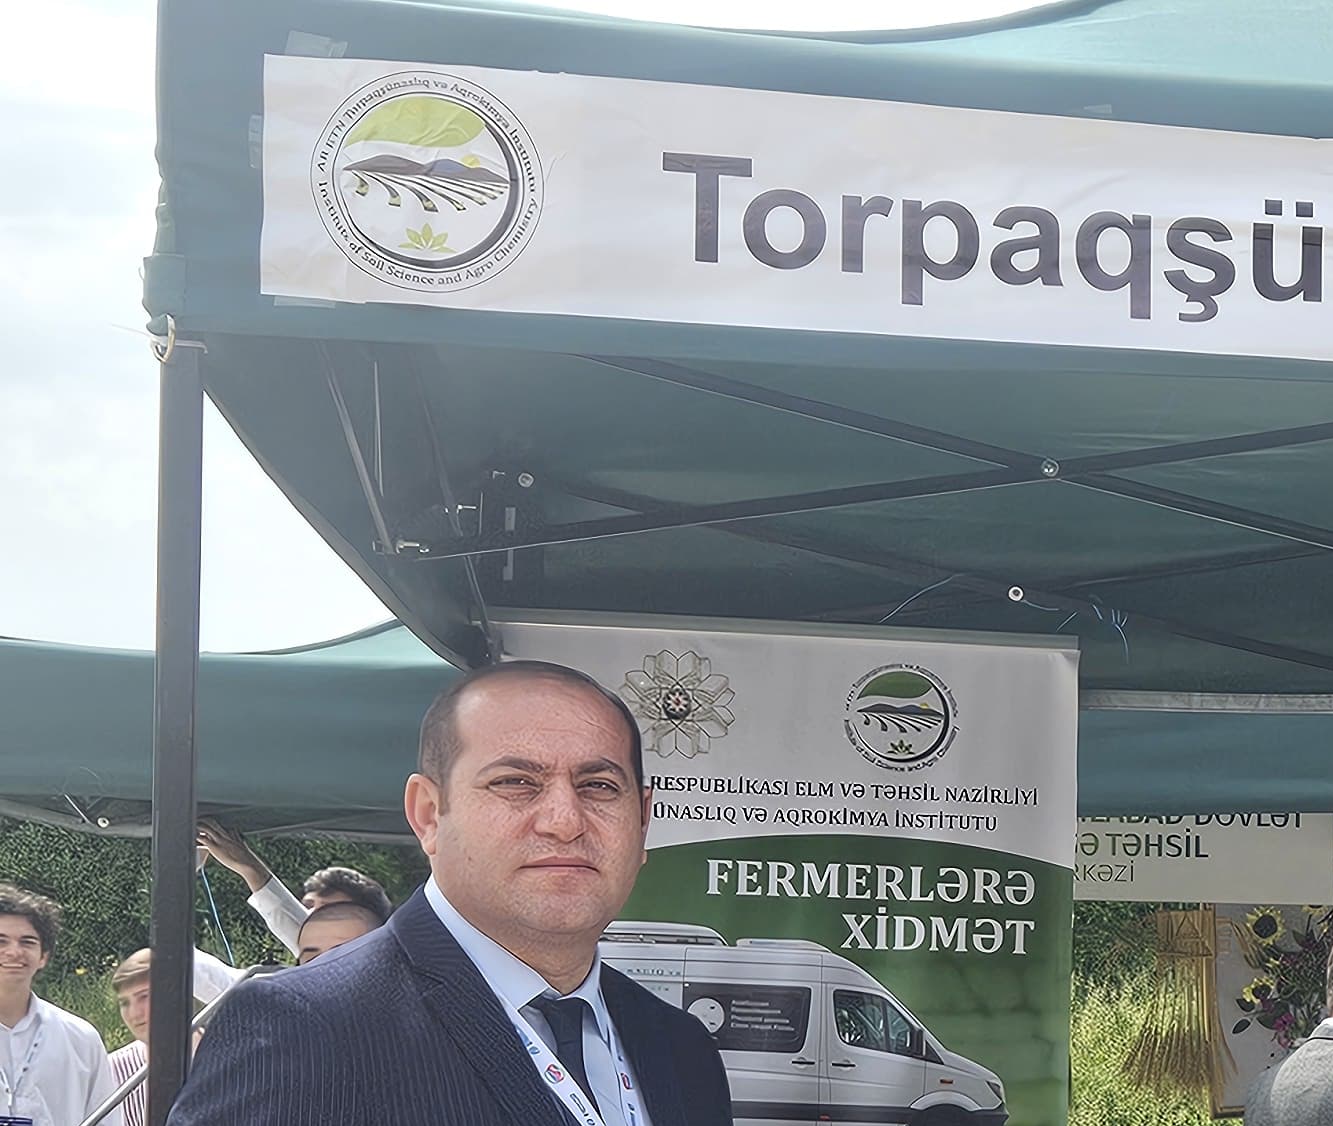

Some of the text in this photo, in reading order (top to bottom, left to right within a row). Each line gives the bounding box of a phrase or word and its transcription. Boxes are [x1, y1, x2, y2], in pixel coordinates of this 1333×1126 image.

[795, 780, 834, 798] ELM
[840, 782, 866, 799] VƏ
[871, 779, 940, 802] TƏHSİL
[945, 783, 1038, 807] NAZİRLİYİ
[742, 806, 768, 824] VƏ
[773, 804, 889, 829] AQROKİMYA
[895, 807, 998, 832] İNSTİTUTU
[1105, 828, 1209, 858] TƏHSİL
[706, 858, 1035, 906] FERMERLƏRƏ
[840, 906, 1034, 956] XİDMƏT
